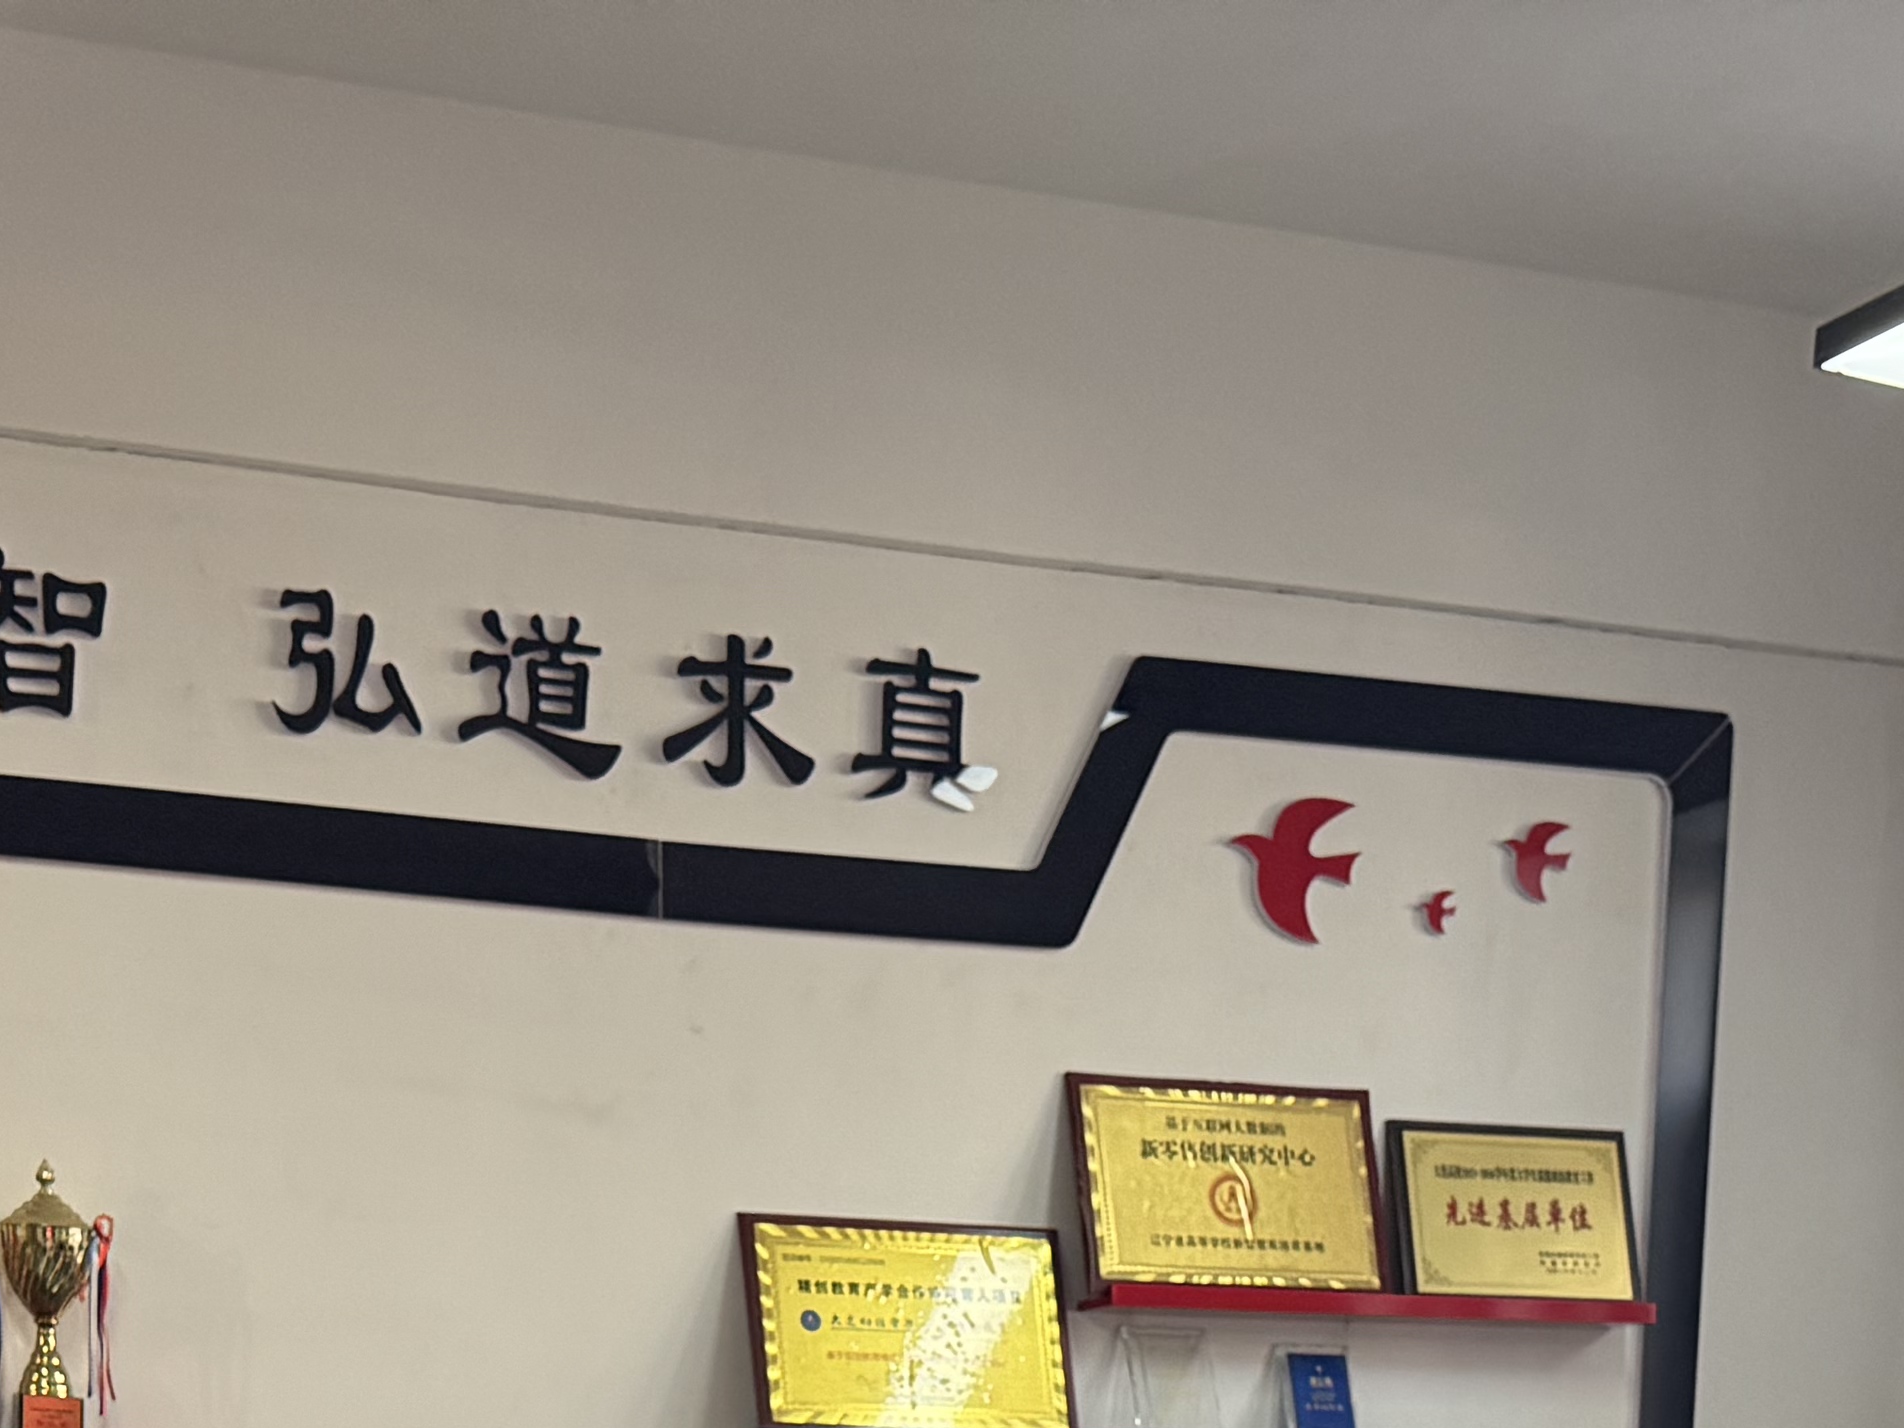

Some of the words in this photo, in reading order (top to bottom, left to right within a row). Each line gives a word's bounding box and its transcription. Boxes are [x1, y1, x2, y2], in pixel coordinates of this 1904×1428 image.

[272, 588, 998, 812] 弘道求真
[1445, 1194, 1593, 1233] 先进基层单位
